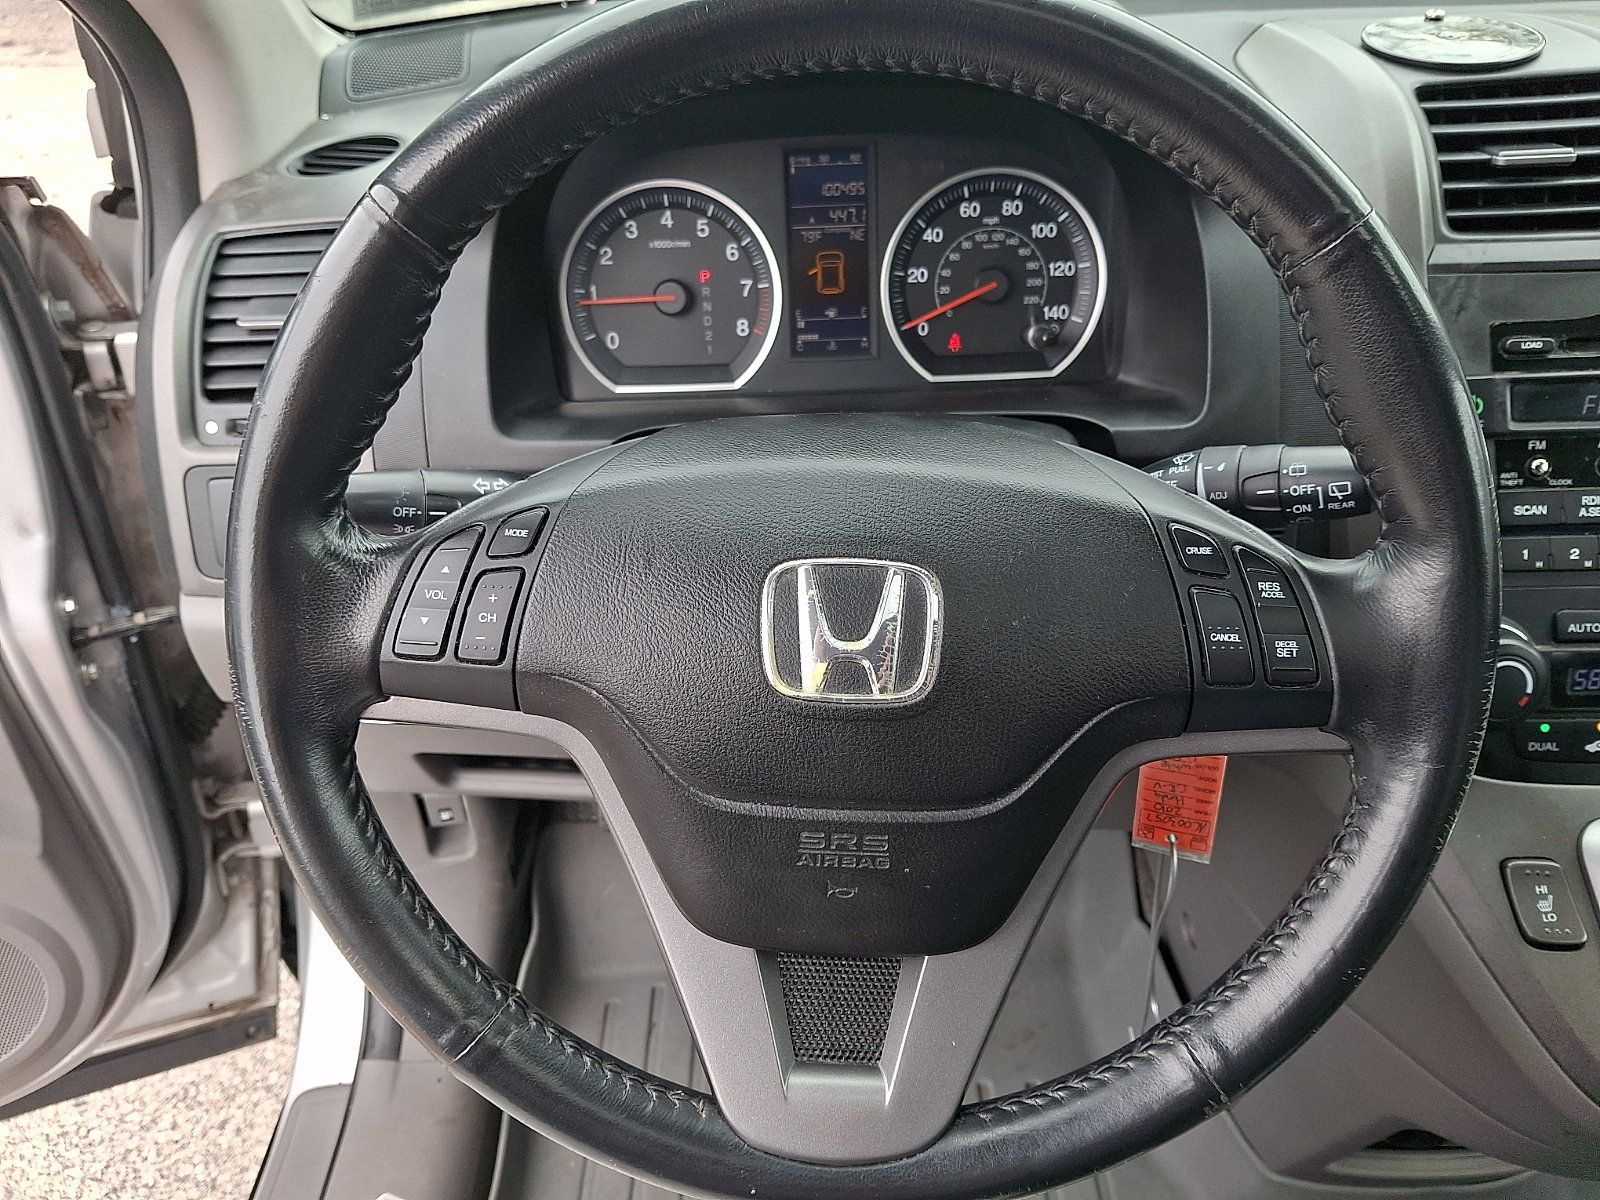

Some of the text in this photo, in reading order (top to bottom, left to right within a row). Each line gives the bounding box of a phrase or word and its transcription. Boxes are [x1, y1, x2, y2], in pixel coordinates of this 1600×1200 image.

[959, 202, 981, 218] 60
[1002, 200, 1023, 217] 80
[660, 211, 673, 228] 4
[624, 221, 639, 239] 3
[696, 220, 710, 238] 5
[1030, 222, 1057, 239] 100
[923, 227, 944, 244] 40
[600, 248, 614, 265] 2
[726, 243, 739, 262] 6
[1049, 261, 1076, 277] 120
[699, 271, 711, 283] P
[907, 268, 929, 284] 20
[589, 286, 598, 301] 1
[702, 287, 711, 297] R
[740, 280, 753, 297] 7
[939, 286, 950, 294] 20
[703, 302, 712, 312] N
[1043, 304, 1070, 321] 140
[704, 316, 712, 327] D
[736, 319, 750, 337] 8
[918, 323, 929, 337] 0
[606, 332, 620, 350] 0
[705, 331, 712, 341] 2
[1521, 341, 1543, 349] LOAD
[1582, 394, 1600, 415] F
[1528, 440, 1547, 450] FM
[1169, 465, 1191, 474] PULL
[1289, 484, 1315, 495] OFF
[1209, 492, 1228, 500] ADJ
[1293, 503, 1311, 513] ON
[1328, 501, 1355, 509] REAR
[1513, 505, 1548, 516] SCAN
[394, 507, 416, 518] OFF
[505, 529, 529, 538] MODE
[1186, 547, 1213, 555] CRUISE
[1522, 549, 1529, 560] 1
[1570, 548, 1580, 560] 2
[1258, 582, 1280, 591] RES
[425, 589, 448, 600] VOL
[1261, 591, 1286, 599] ACCEL
[479, 613, 497, 623] CH
[1568, 623, 1600, 633] AUTO
[1210, 633, 1242, 642] CANCEL
[1277, 648, 1299, 658] SET
[1528, 742, 1560, 751] DUAL
[799, 831, 889, 851] SRS
[796, 853, 890, 869] AIRBAG
[1535, 885, 1548, 894] HI
[1542, 913, 1557, 922] LO
